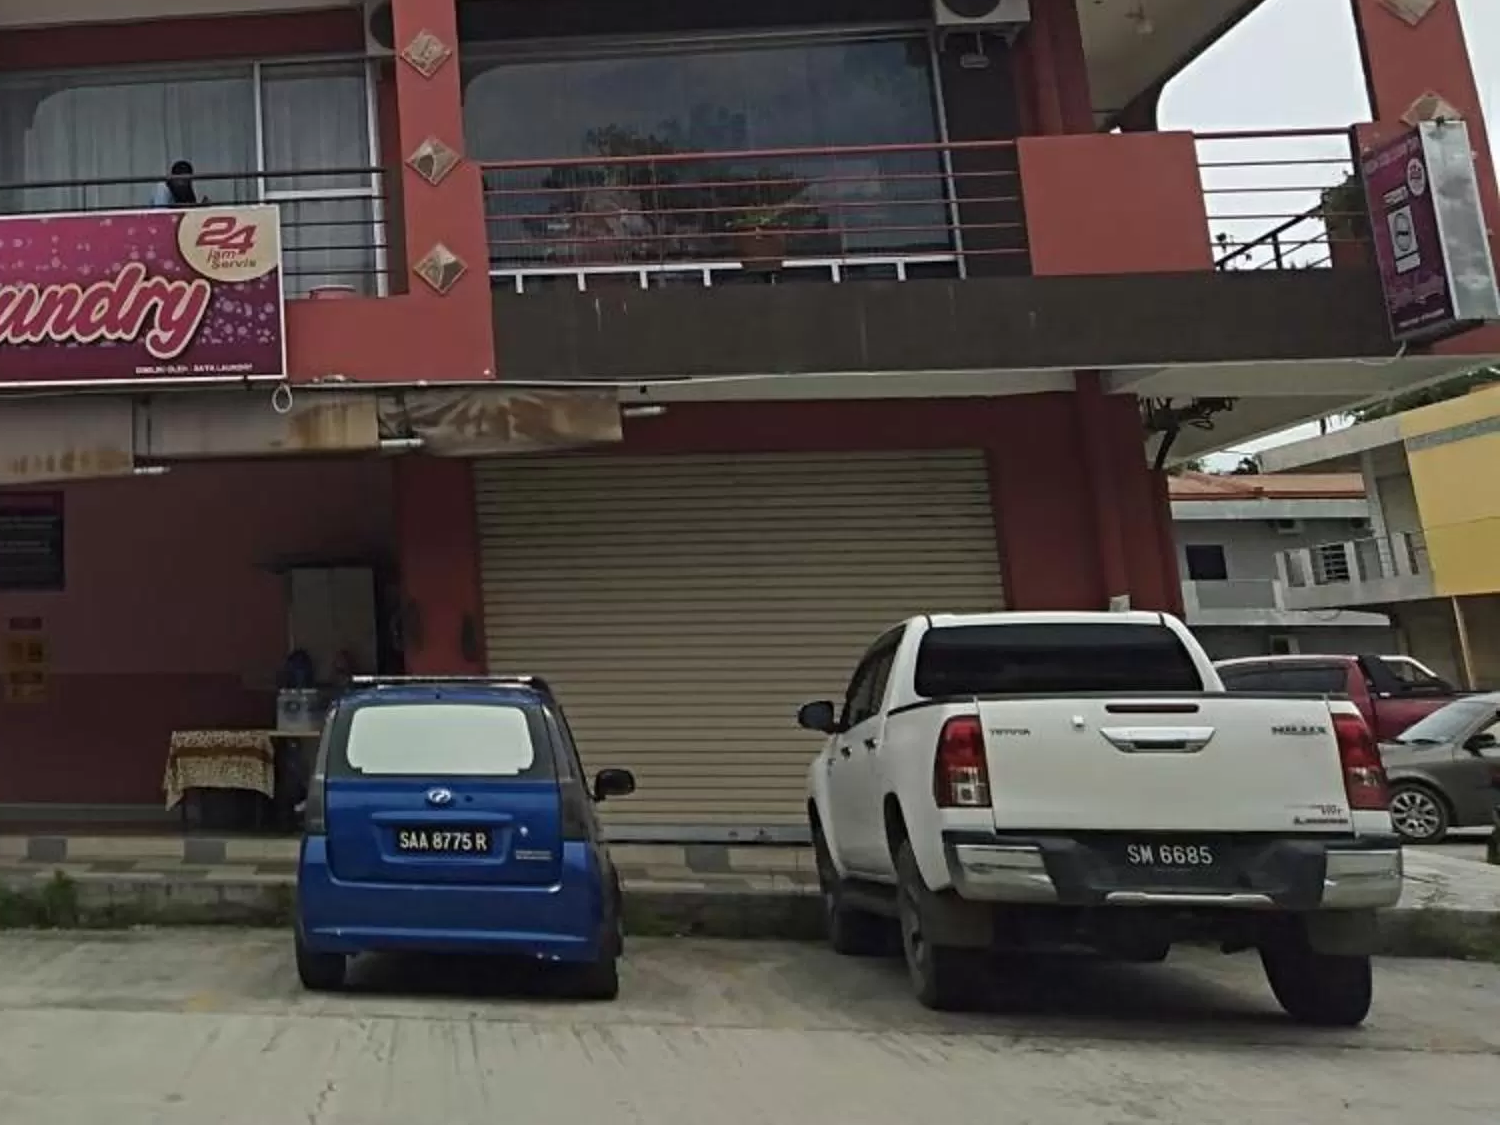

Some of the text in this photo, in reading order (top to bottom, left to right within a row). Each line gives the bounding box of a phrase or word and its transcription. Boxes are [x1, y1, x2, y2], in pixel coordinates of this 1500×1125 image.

[196, 216, 257, 255] 24
[400, 831, 487, 851] SAA 8775 R
[1127, 843, 1213, 865] SM 6685
